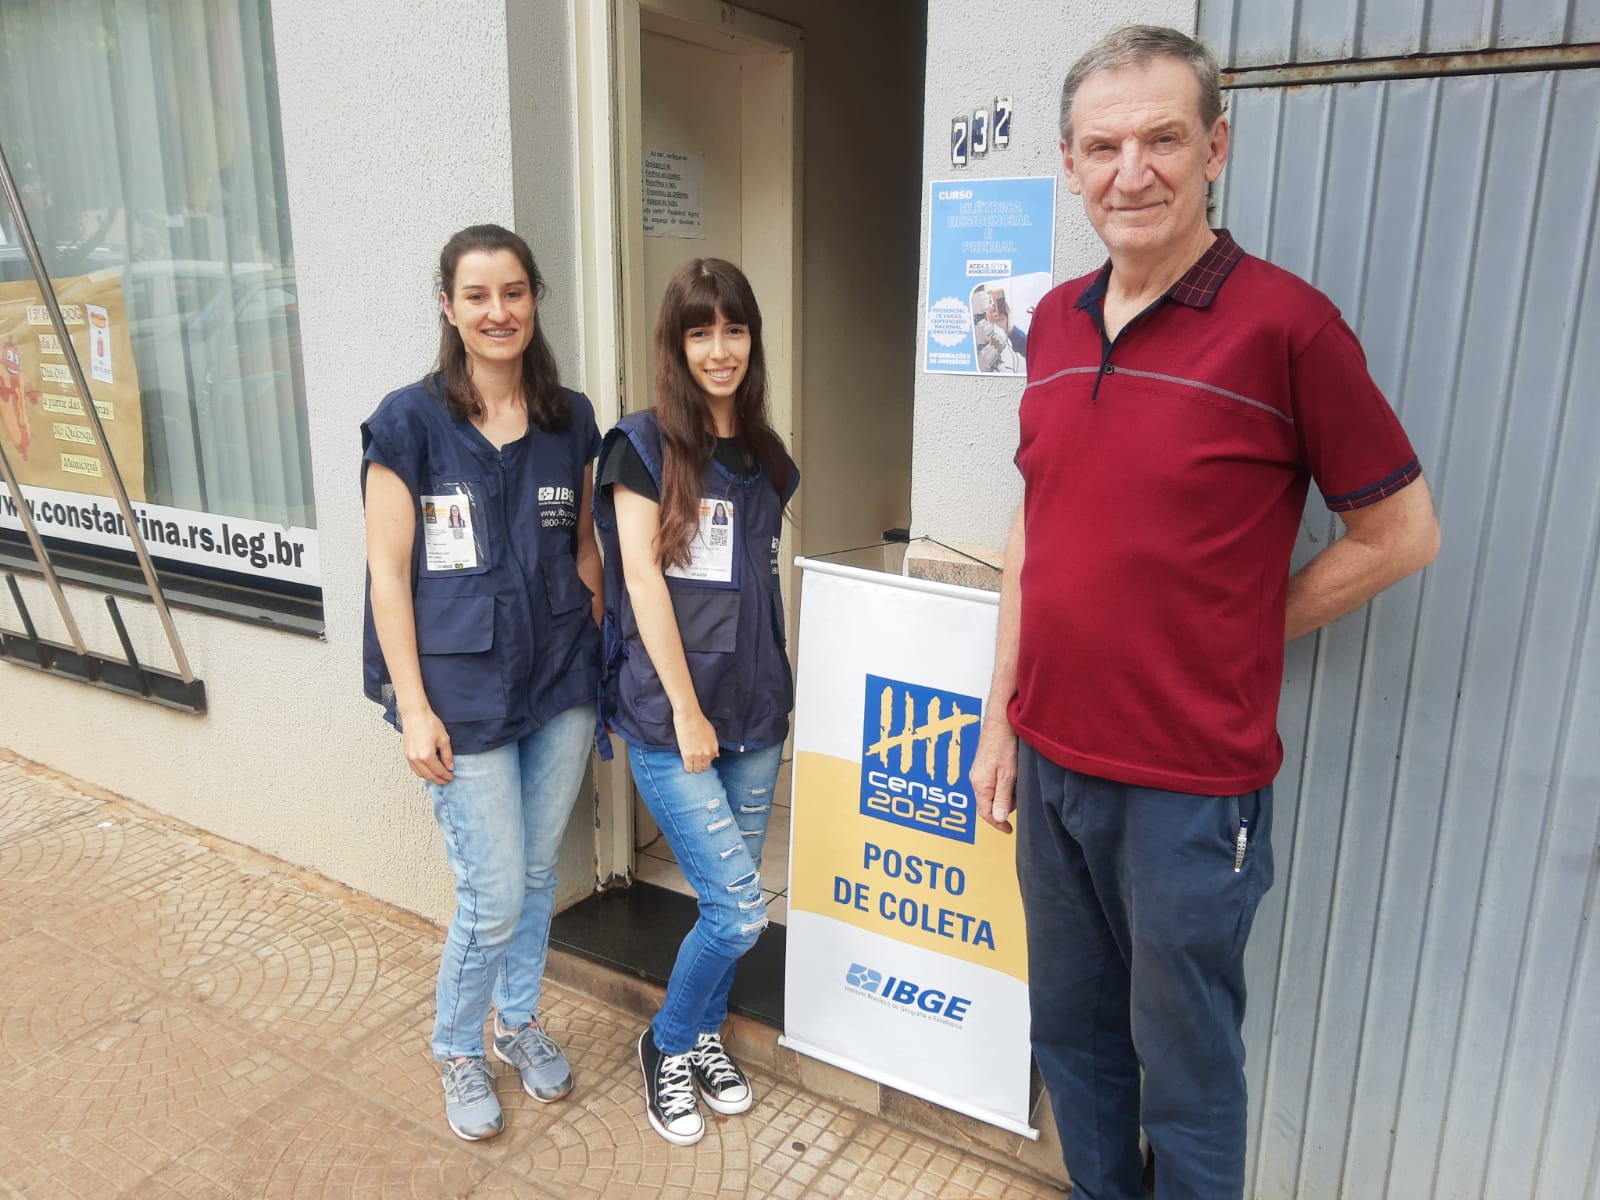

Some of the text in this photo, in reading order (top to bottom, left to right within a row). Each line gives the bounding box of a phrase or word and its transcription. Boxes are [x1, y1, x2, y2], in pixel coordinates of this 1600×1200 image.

[952, 100, 1011, 164] 232
[938, 190, 973, 201] CURSO
[959, 200, 1023, 215] ELÉTRICA
[63, 457, 99, 473] Municipal
[868, 770, 968, 809] censo
[867, 790, 967, 833] 2022
[863, 841, 966, 897] POSTO
[833, 875, 996, 951] DE COLETA
[867, 992, 891, 1008] Brasileiro
[900, 1005, 927, 1020] Geografia
[881, 976, 973, 1022] IBGE
